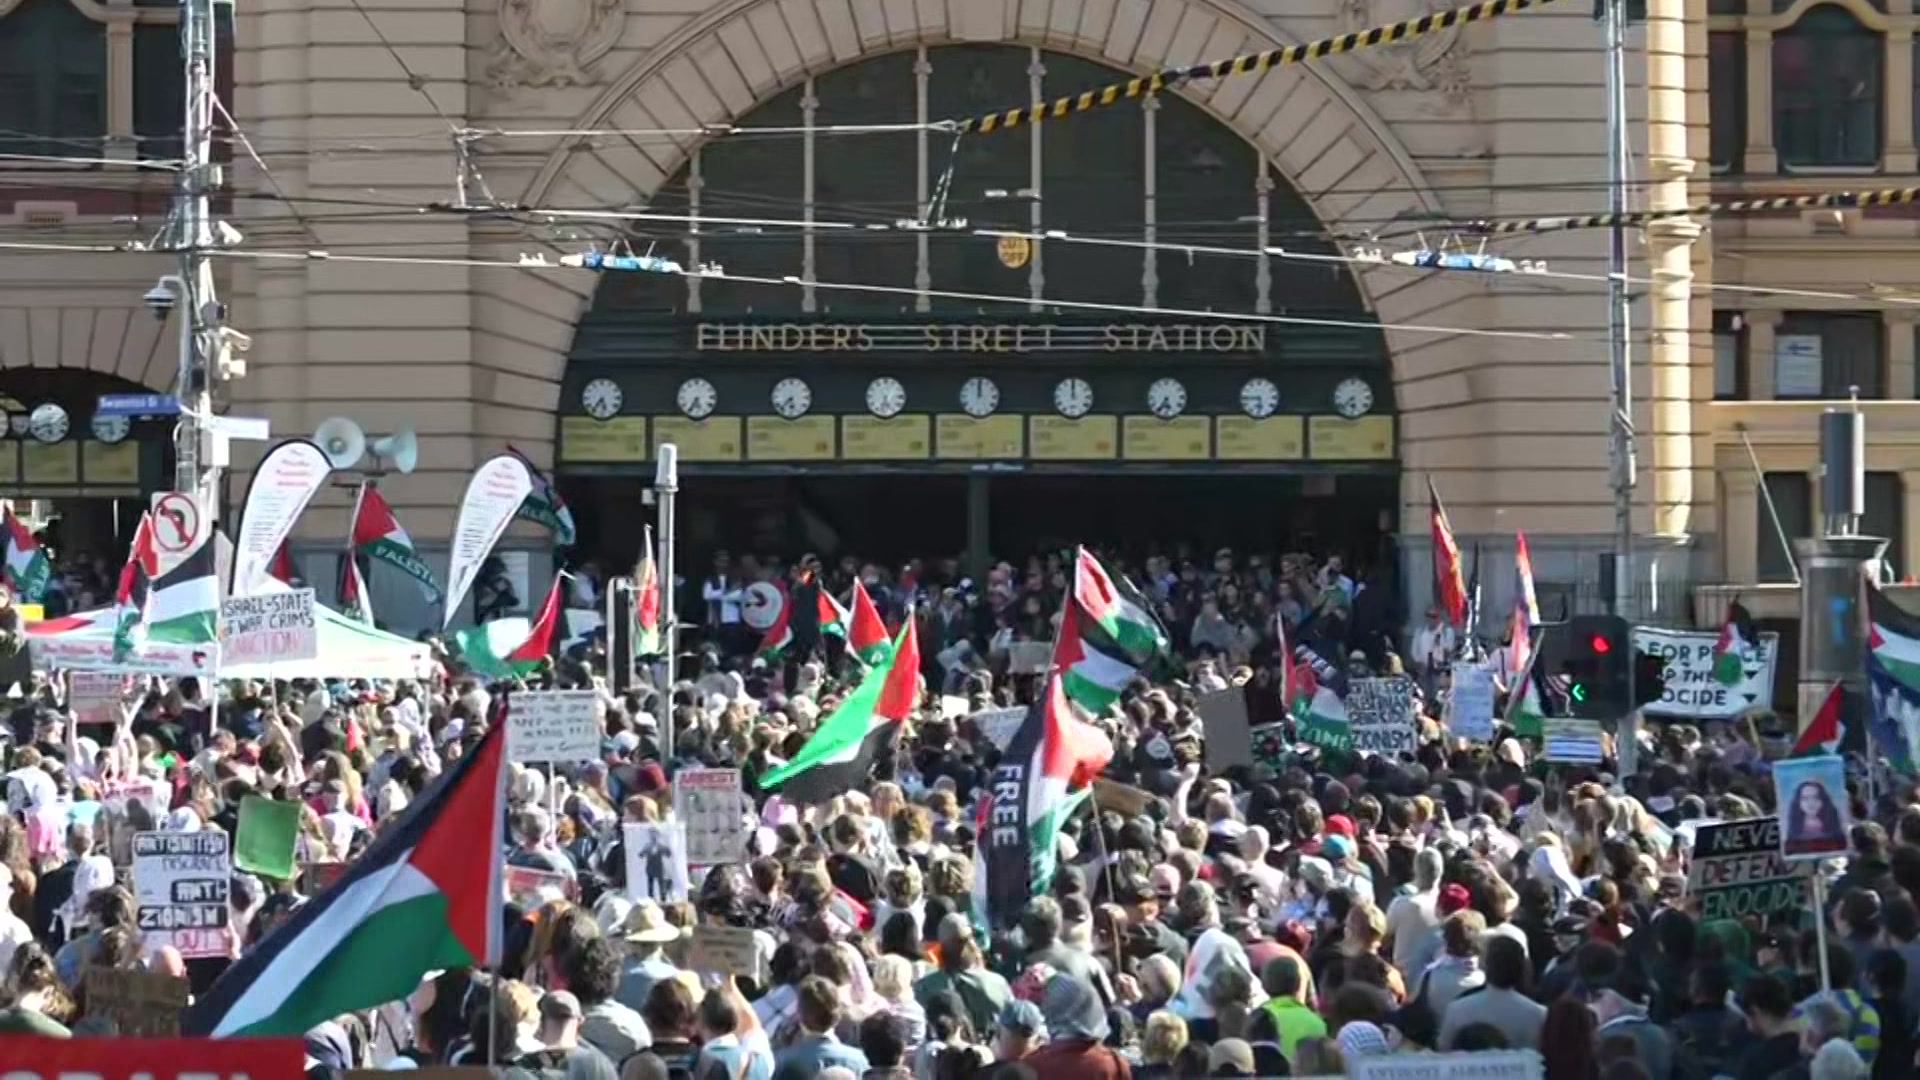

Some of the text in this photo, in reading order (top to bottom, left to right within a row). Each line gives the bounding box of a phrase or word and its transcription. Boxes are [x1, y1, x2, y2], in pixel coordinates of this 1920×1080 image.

[697, 324, 1266, 352] FLINDERS STREET STATION
[1663, 687, 1728, 706] OCIDE
[992, 763, 1024, 847] FREE
[1713, 821, 1780, 850] NEVE
